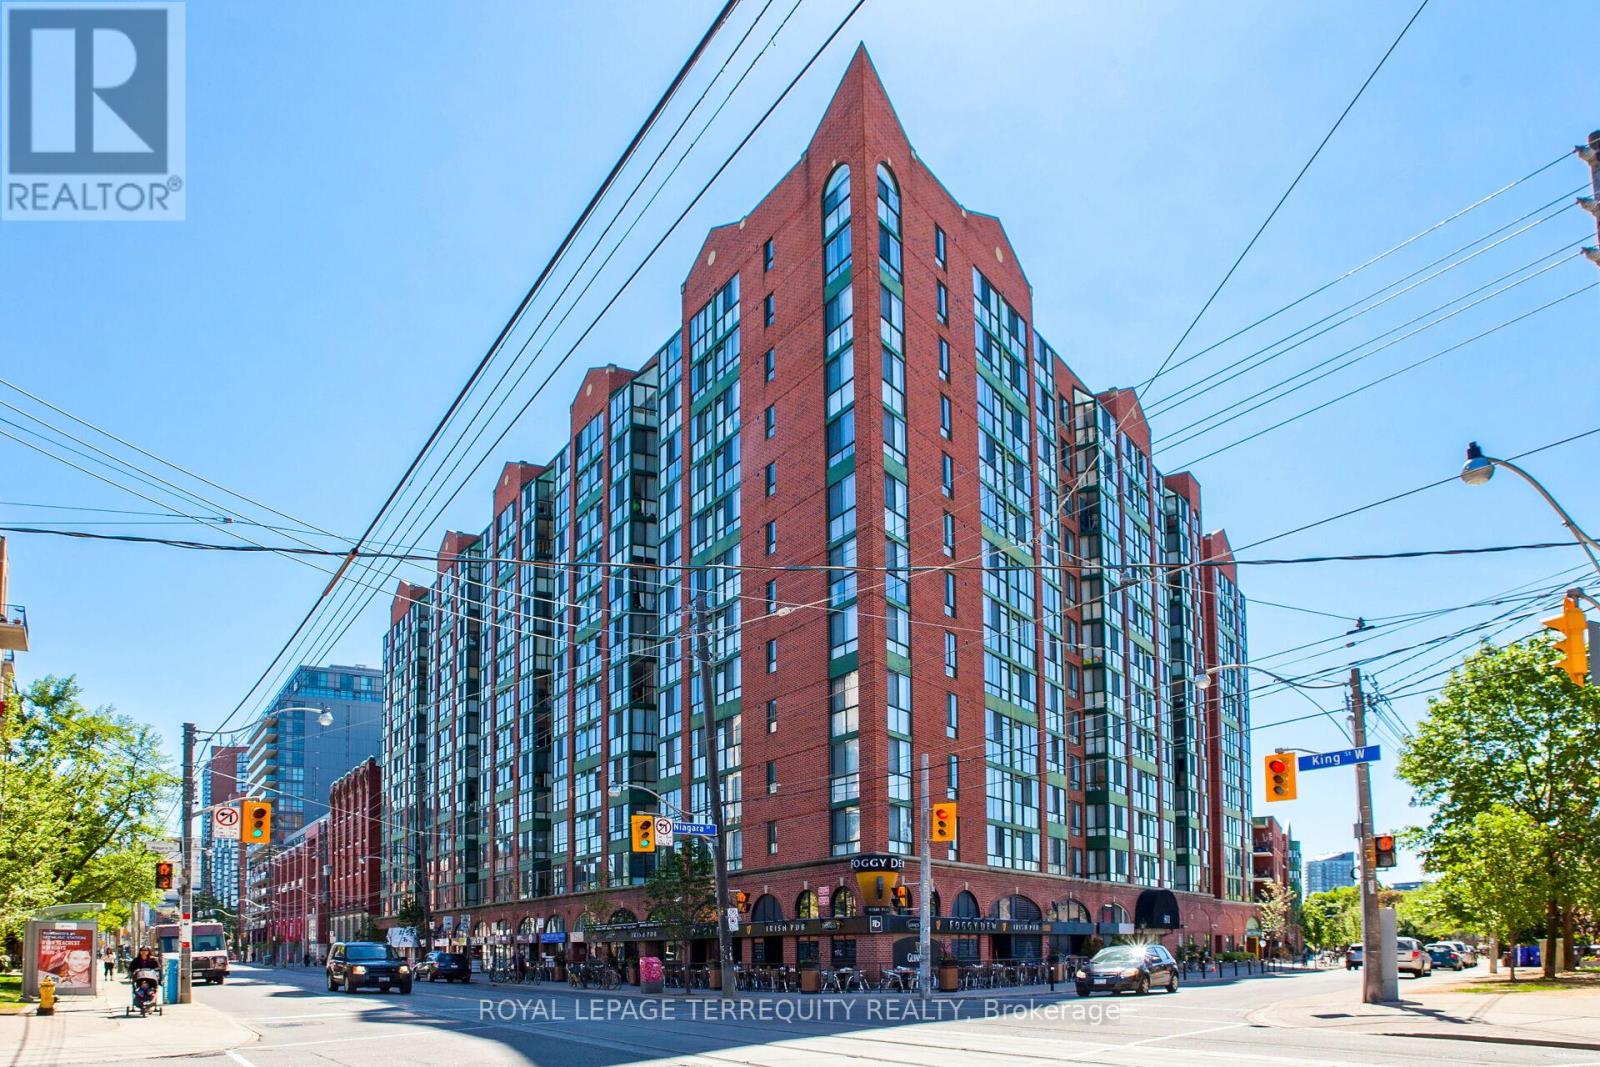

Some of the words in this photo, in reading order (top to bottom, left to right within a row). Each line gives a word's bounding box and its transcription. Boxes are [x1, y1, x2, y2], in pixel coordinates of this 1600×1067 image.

[1312, 754, 1340, 766] King
[1354, 749, 1365, 760] W
[673, 823, 704, 833] Niagara
[850, 859, 887, 869] FOGGY
[766, 924, 787, 932] IRISH
[790, 923, 805, 931] PUB
[949, 920, 977, 930] FOGGY
[980, 921, 997, 930] DEW
